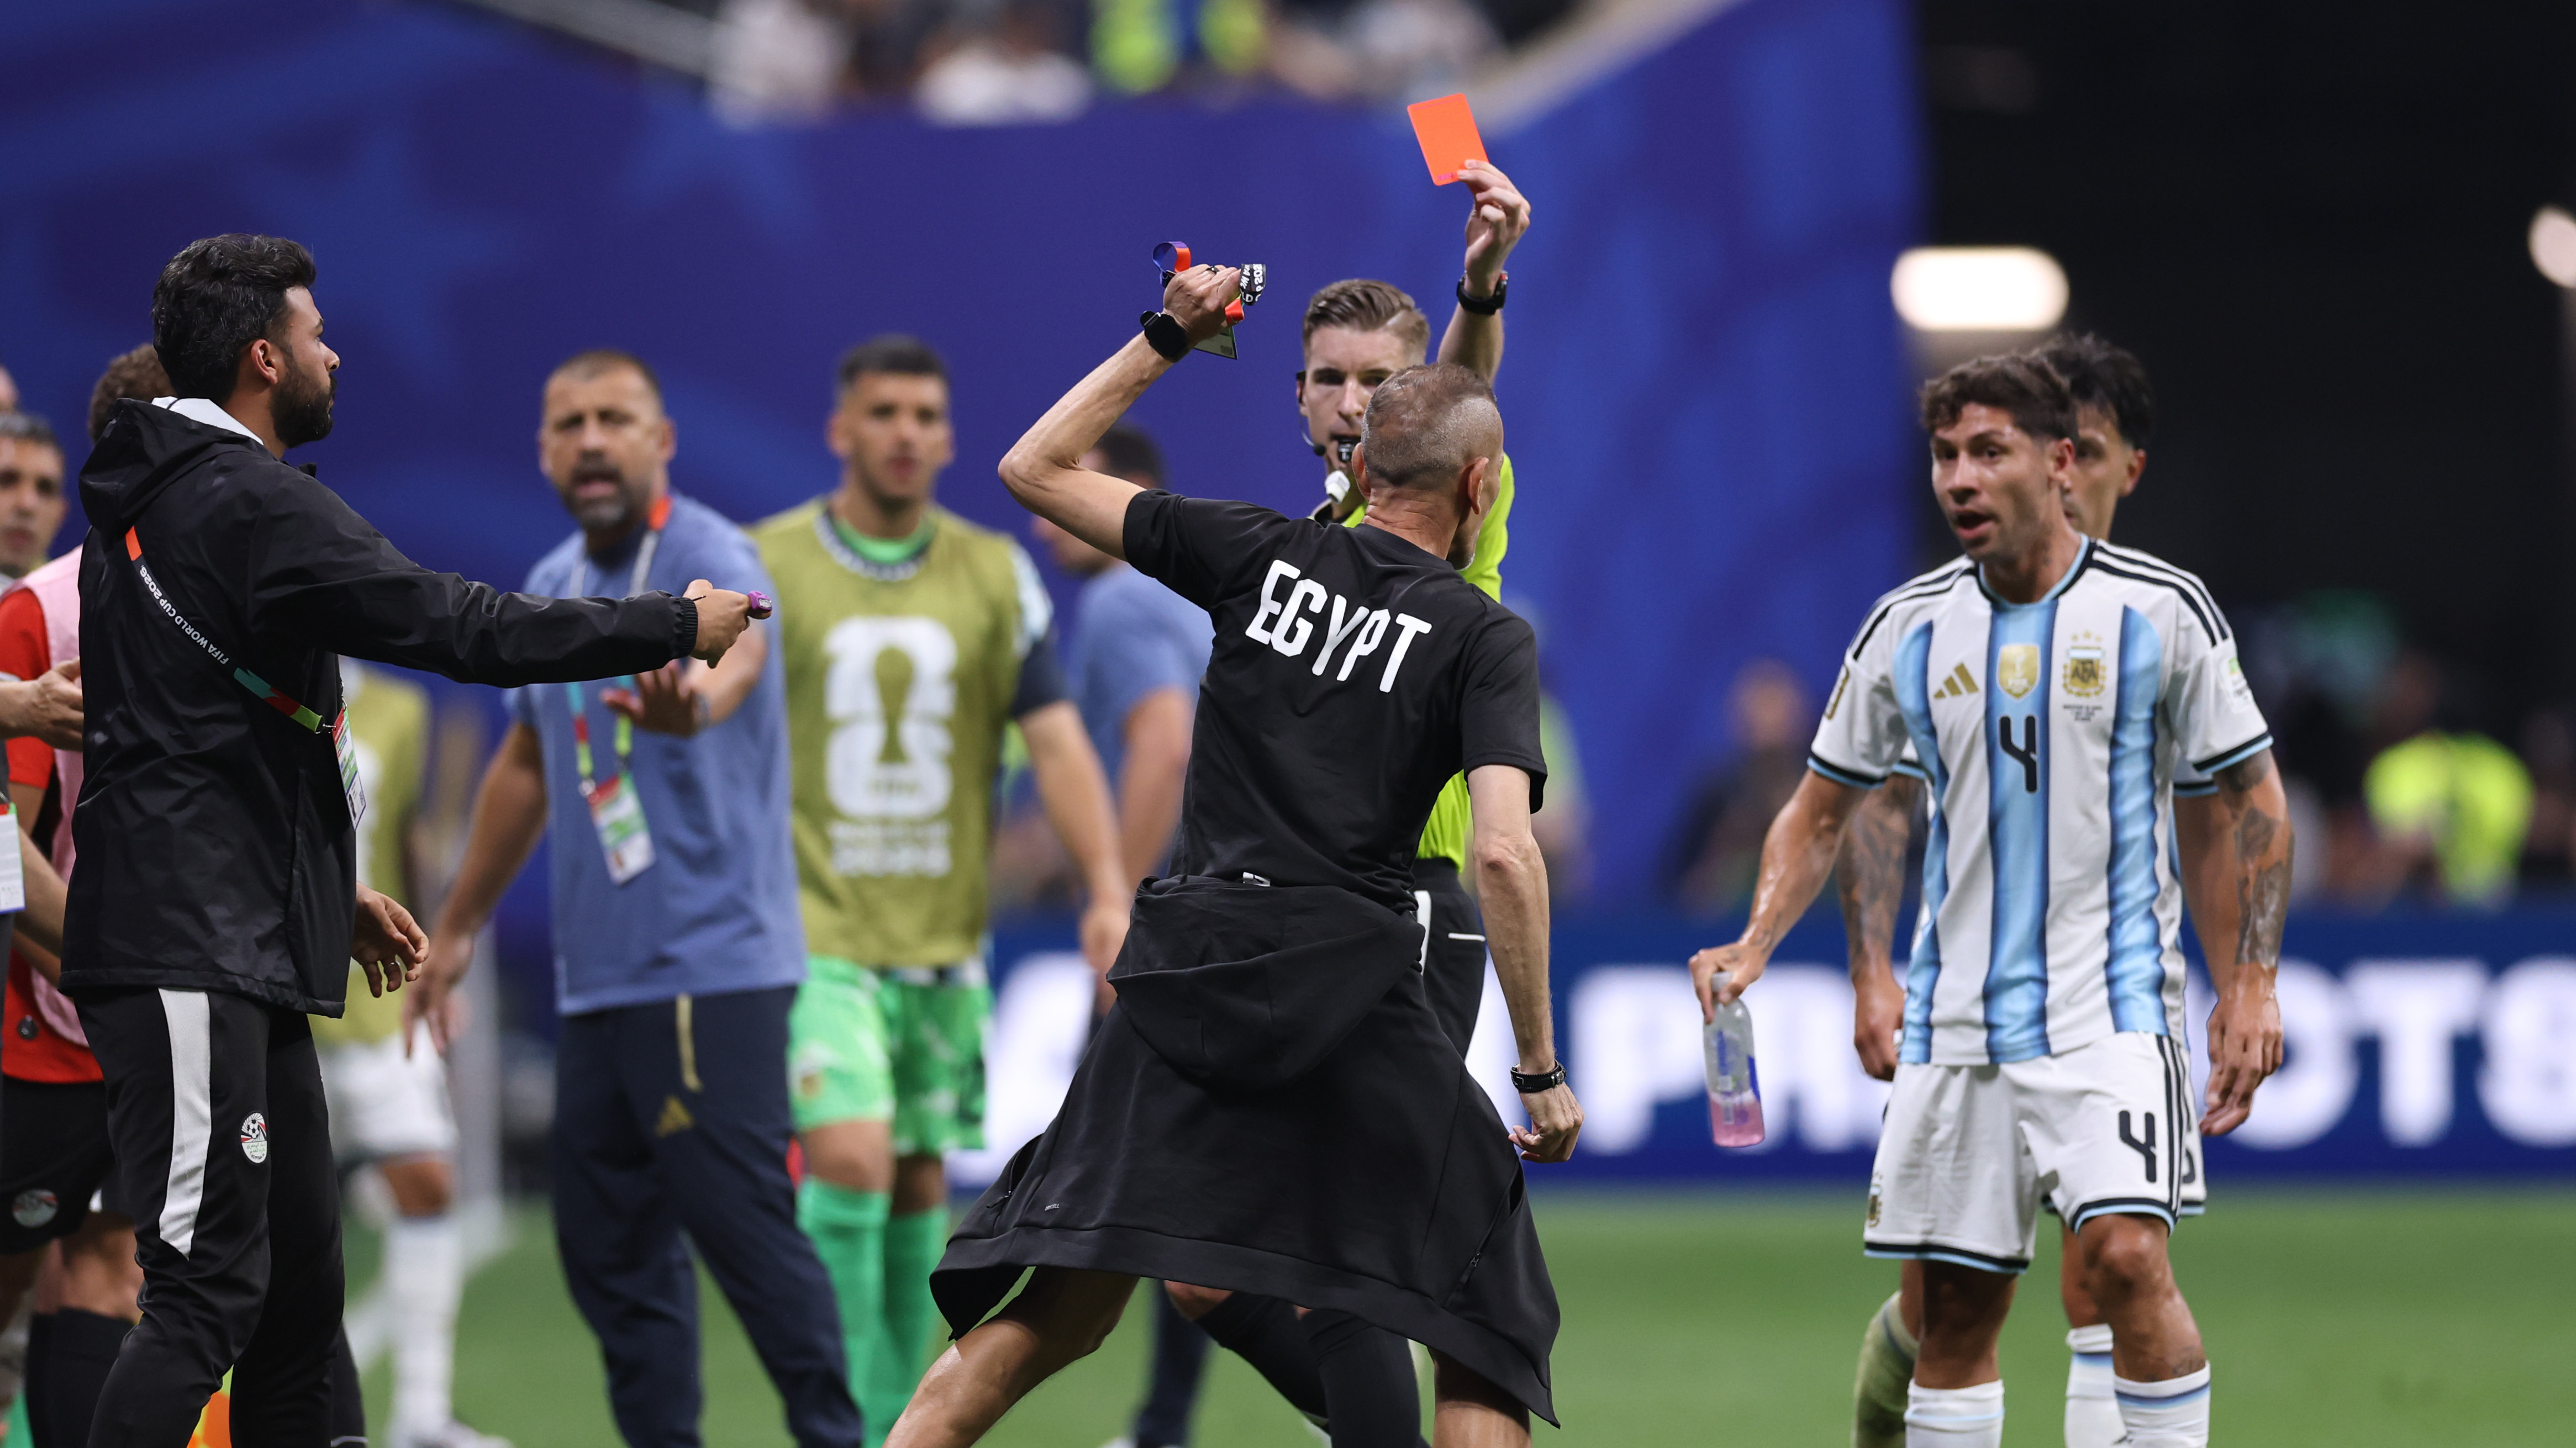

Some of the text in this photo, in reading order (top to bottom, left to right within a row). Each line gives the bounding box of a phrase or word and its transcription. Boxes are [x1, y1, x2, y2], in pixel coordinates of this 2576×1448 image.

[140, 566, 229, 664] FIFA WORLD CUP 2026
[1245, 559, 1432, 693] EGYPT
[1999, 715, 2038, 793] 4
[2119, 1110, 2157, 1183] 4
